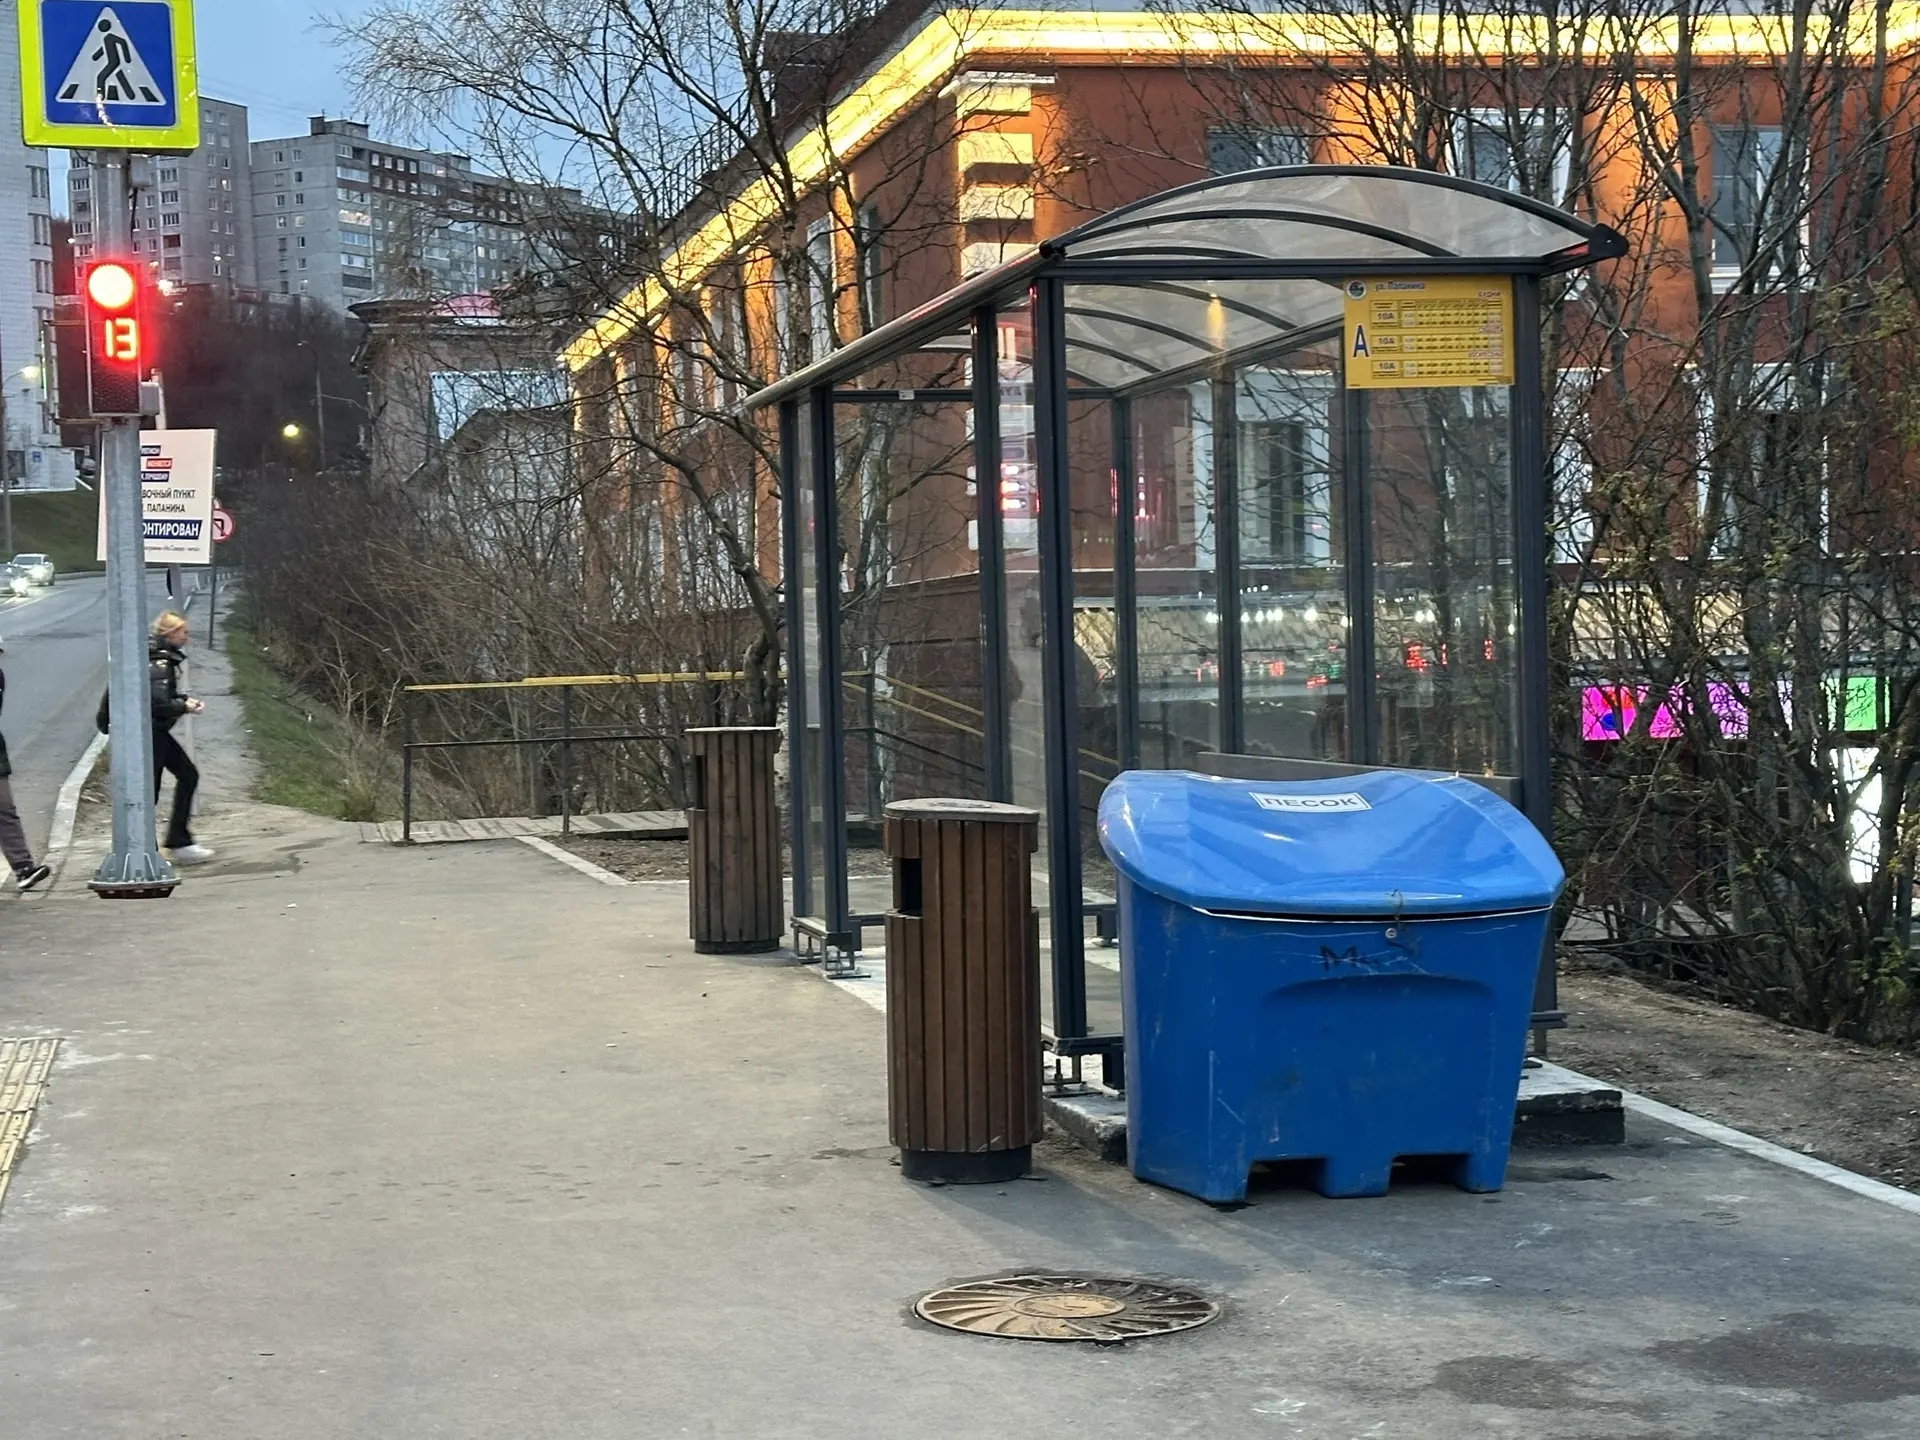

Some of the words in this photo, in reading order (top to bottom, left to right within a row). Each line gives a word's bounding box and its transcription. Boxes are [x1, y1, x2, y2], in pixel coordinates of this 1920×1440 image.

[105, 317, 137, 360] 13
[173, 489, 195, 499] ПУНКТ
[147, 503, 186, 512] ПАПАНИНА
[1263, 797, 1358, 808] ПЕСОК
